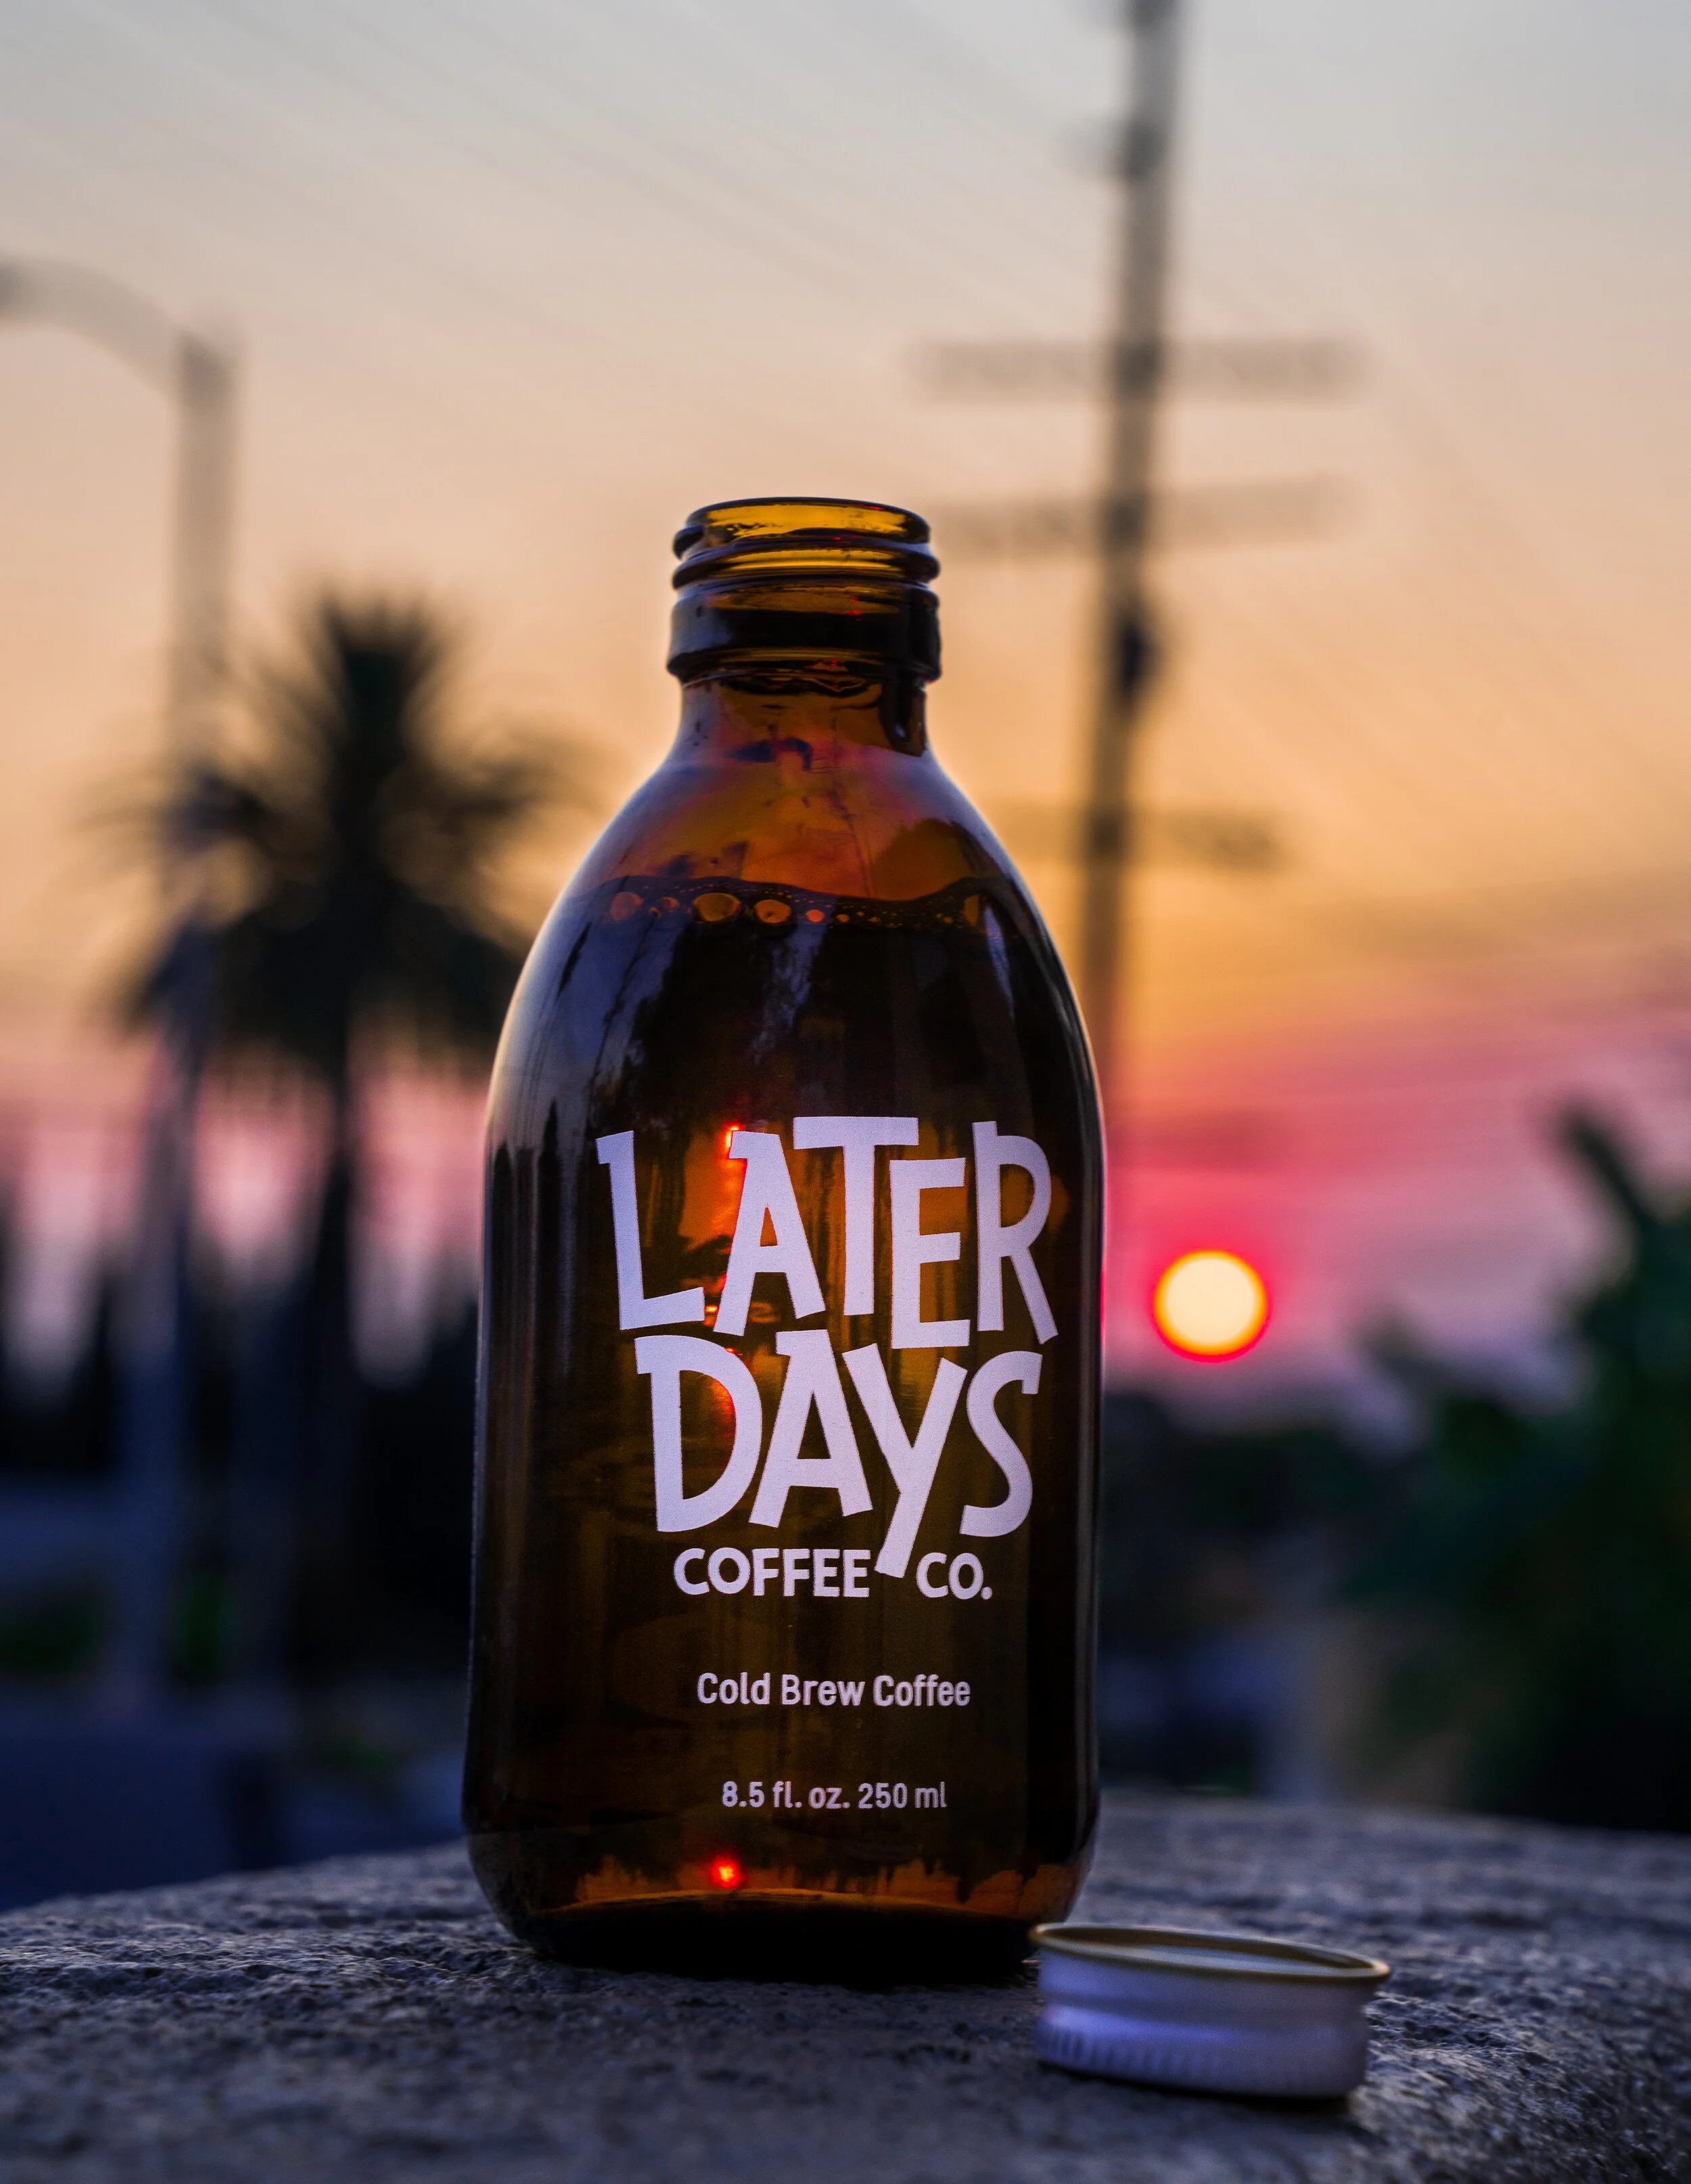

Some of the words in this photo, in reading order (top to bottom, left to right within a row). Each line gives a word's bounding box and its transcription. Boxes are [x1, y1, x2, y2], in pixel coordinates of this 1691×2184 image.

[595, 1116, 1059, 1350] LATER
[634, 1329, 1043, 1578] DAYS
[673, 1547, 872, 1597] COFFEE
[915, 1552, 993, 1600] CO.
[697, 1672, 770, 1705] Cold
[781, 1674, 865, 1706] Brew
[873, 1674, 971, 1707] Coffee
[722, 1781, 765, 1808] 8.5
[772, 1781, 803, 1808] fl.
[808, 1787, 850, 1809] oz.
[858, 1782, 908, 1809] 250
[914, 1781, 948, 1808] ml
